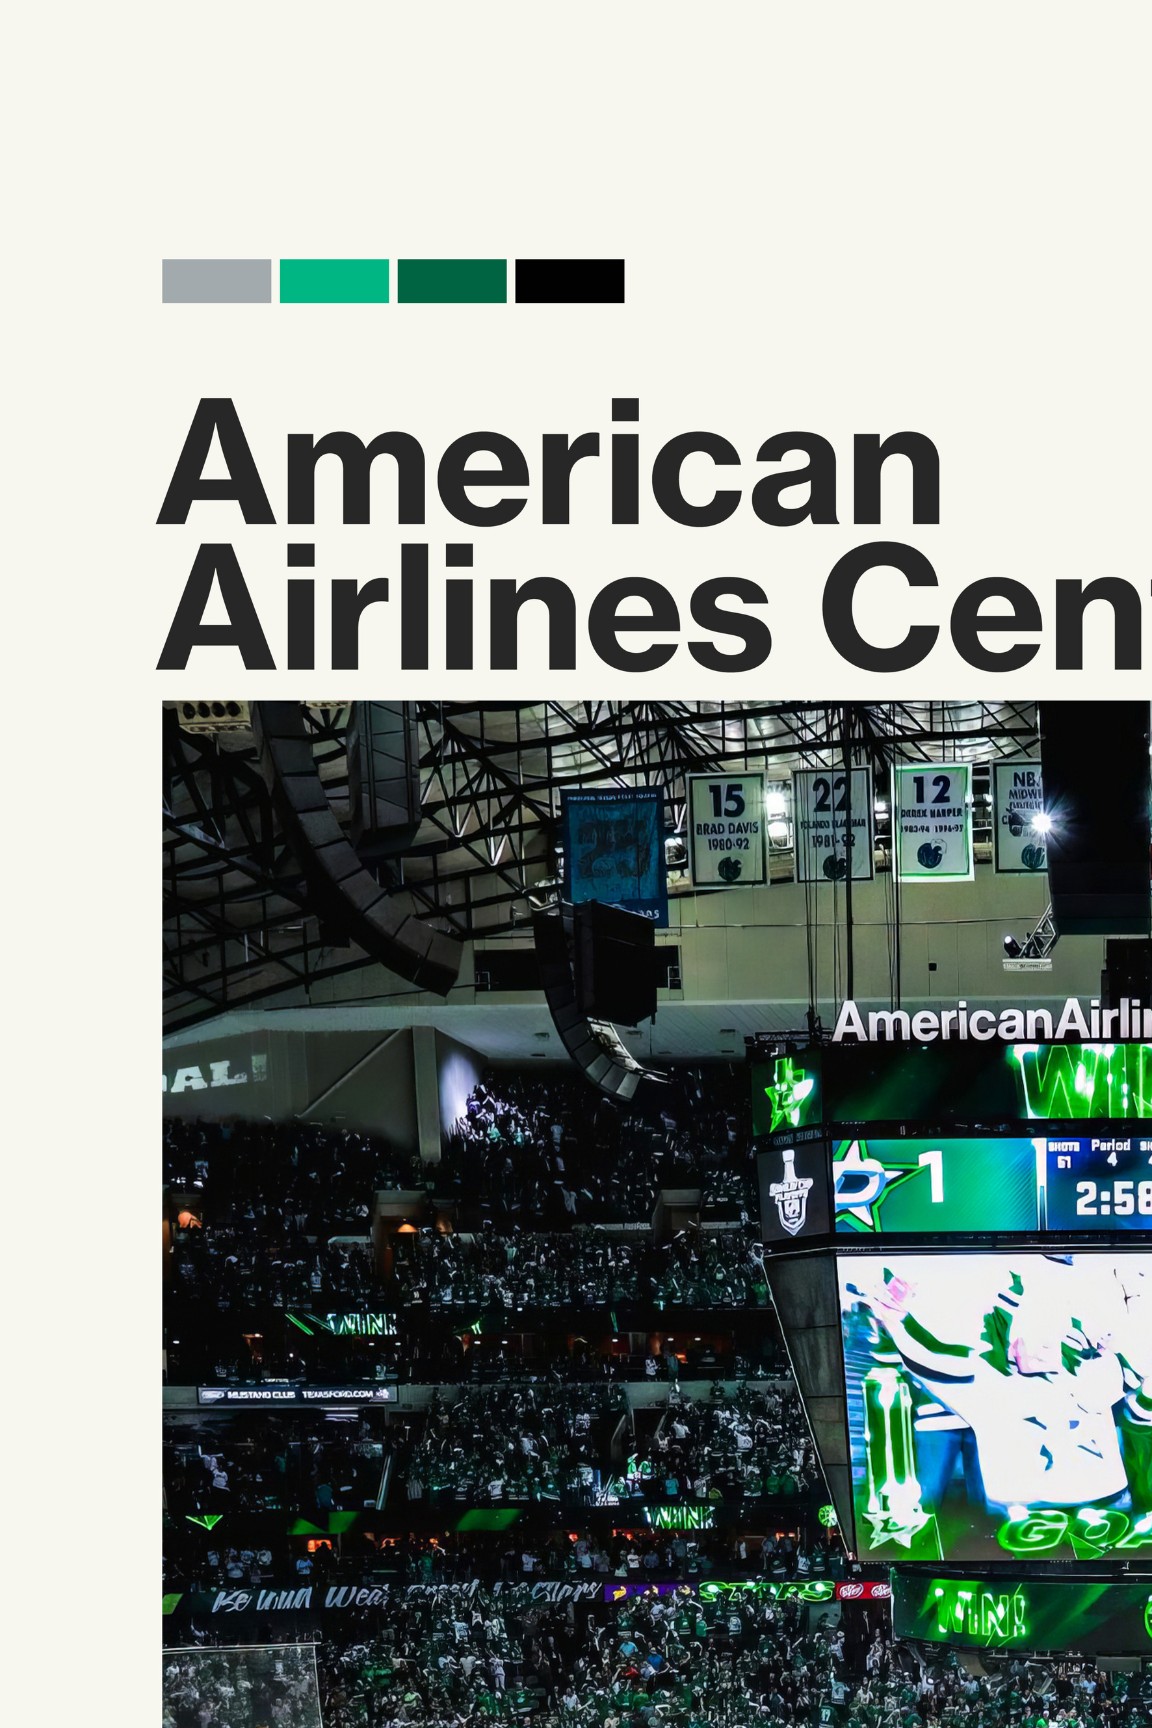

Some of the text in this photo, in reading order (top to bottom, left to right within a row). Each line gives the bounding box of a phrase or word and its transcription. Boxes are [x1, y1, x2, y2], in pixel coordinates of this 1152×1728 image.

[708, 783, 747, 818] 15
[812, 776, 852, 813] 22
[912, 774, 951, 804] 12
[696, 820, 759, 836] BRAD DAVIS
[707, 837, 751, 851] 1980-92
[1090, 1138, 1131, 1152] Period
[1106, 1151, 1118, 1167] 4
[918, 1150, 945, 1204] 1
